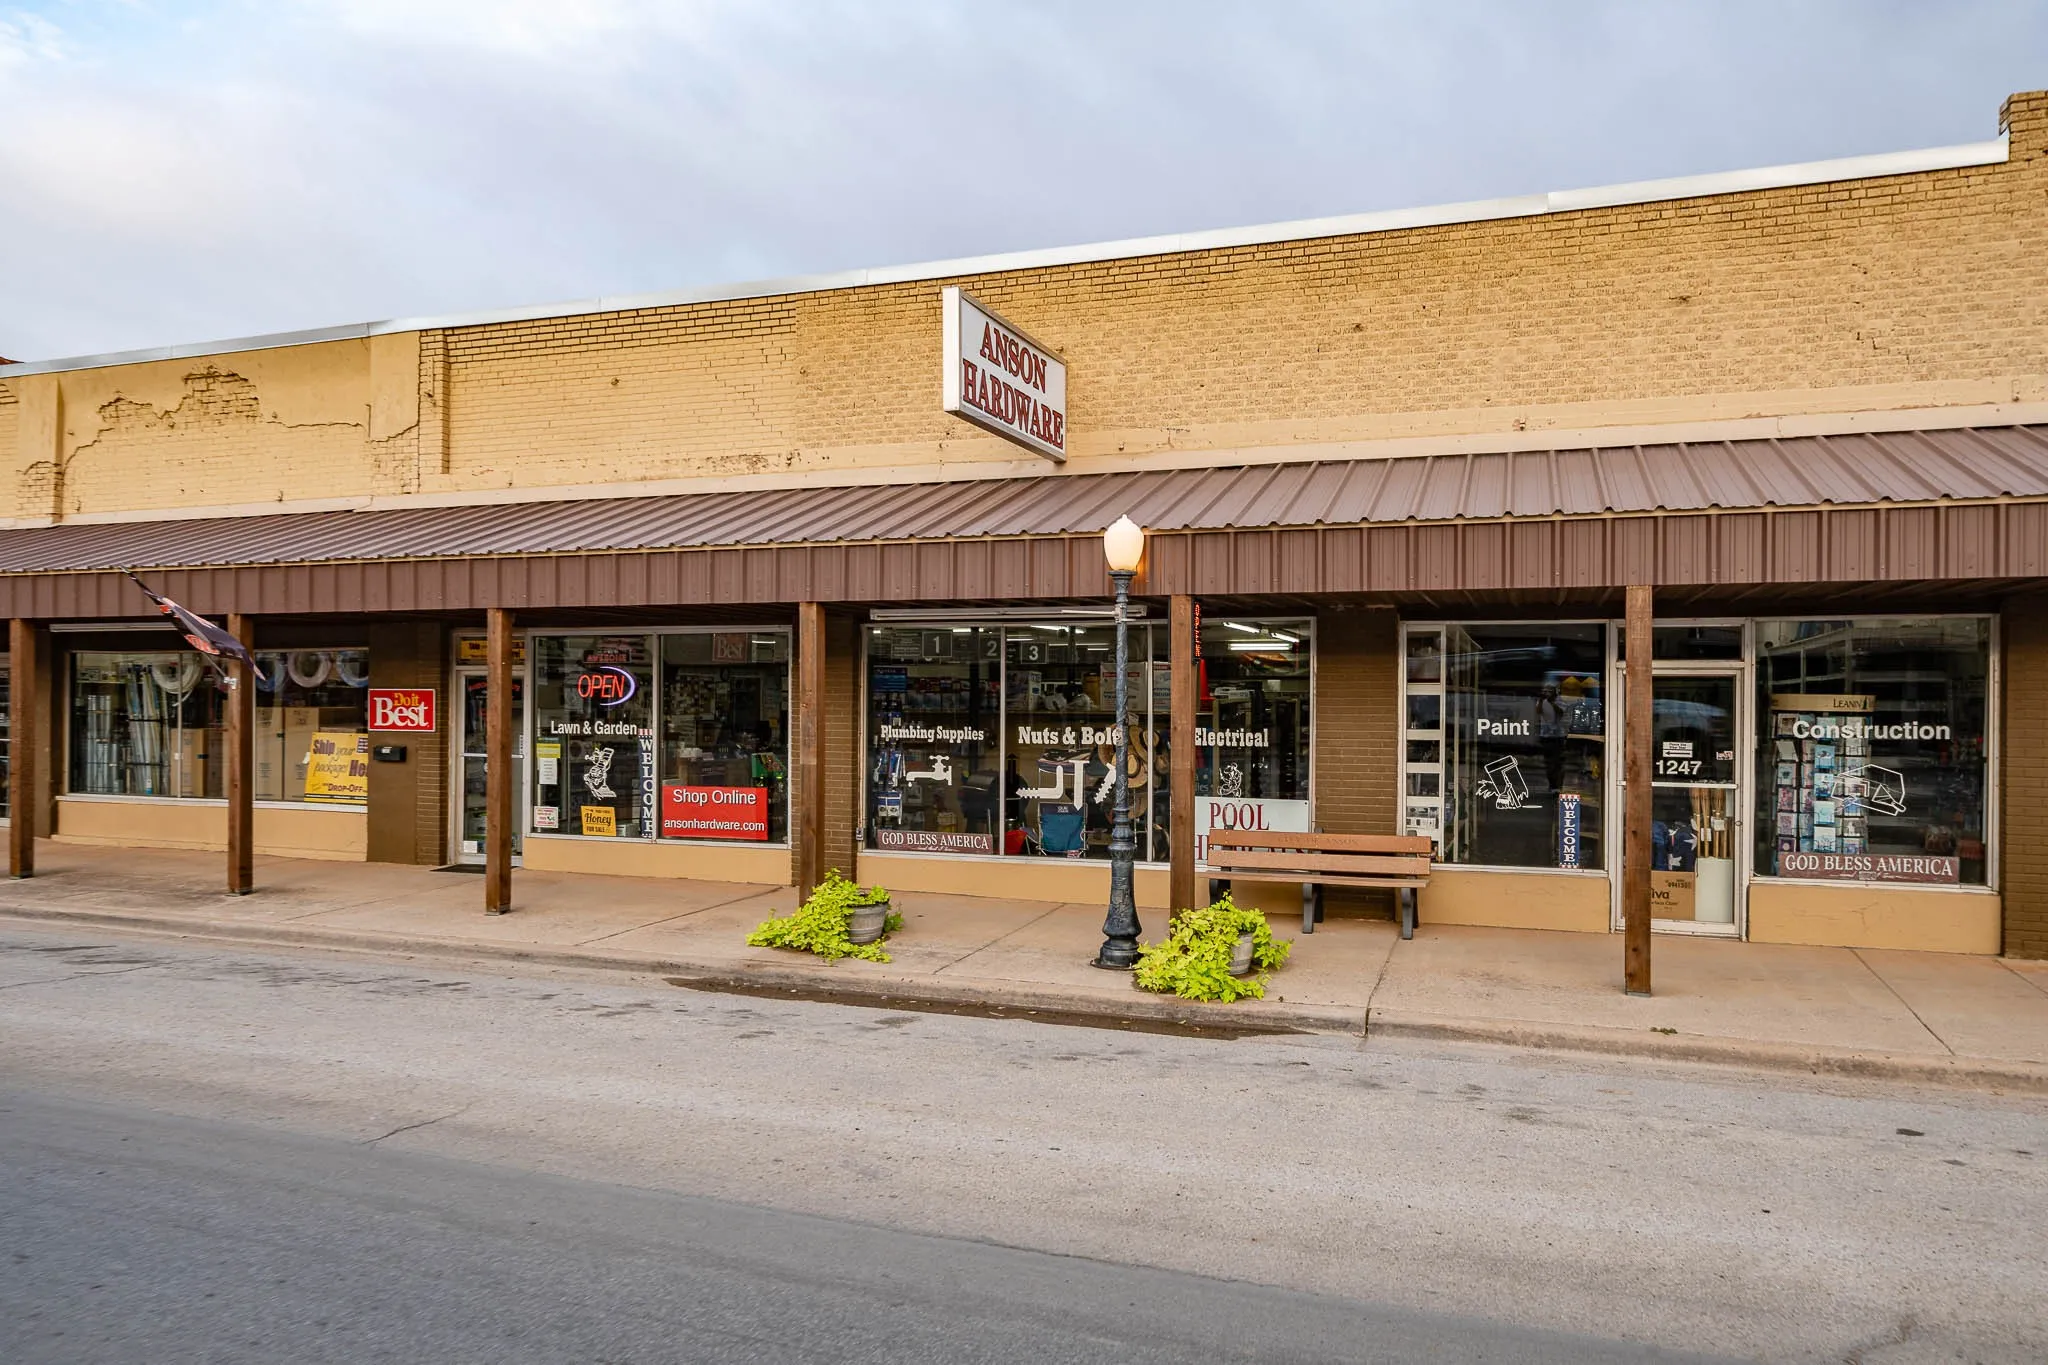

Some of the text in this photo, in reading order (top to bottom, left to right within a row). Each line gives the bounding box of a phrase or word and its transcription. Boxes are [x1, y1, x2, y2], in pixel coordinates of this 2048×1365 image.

[979, 321, 1048, 394] ANSON
[962, 358, 1064, 449] HARDWARE
[1028, 646, 1039, 661] 3
[577, 674, 625, 698] OPEN
[393, 692, 420, 706] Do it
[373, 697, 429, 727] Best
[550, 720, 638, 735] Lawn & Garden
[880, 724, 984, 743] Plumbing Supplies
[1018, 726, 1059, 745] Nuts
[1062, 726, 1076, 745] &
[1477, 718, 1530, 736] Paint
[1792, 720, 1951, 740] Construction
[1194, 727, 1269, 748] Electrical
[312, 739, 335, 756] Ship
[1655, 759, 1703, 775] 1247
[673, 789, 757, 806] Shop Online
[584, 812, 612, 827] Honey
[664, 818, 765, 831] ansonhardware.com
[1209, 802, 1270, 831] POOL
[881, 831, 904, 845] GOD
[906, 833, 938, 846] BLESS
[939, 834, 989, 850] AMERICA
[1562, 801, 1577, 862] WELCOME
[1784, 854, 1953, 876] GOD BLESS AMERICA
